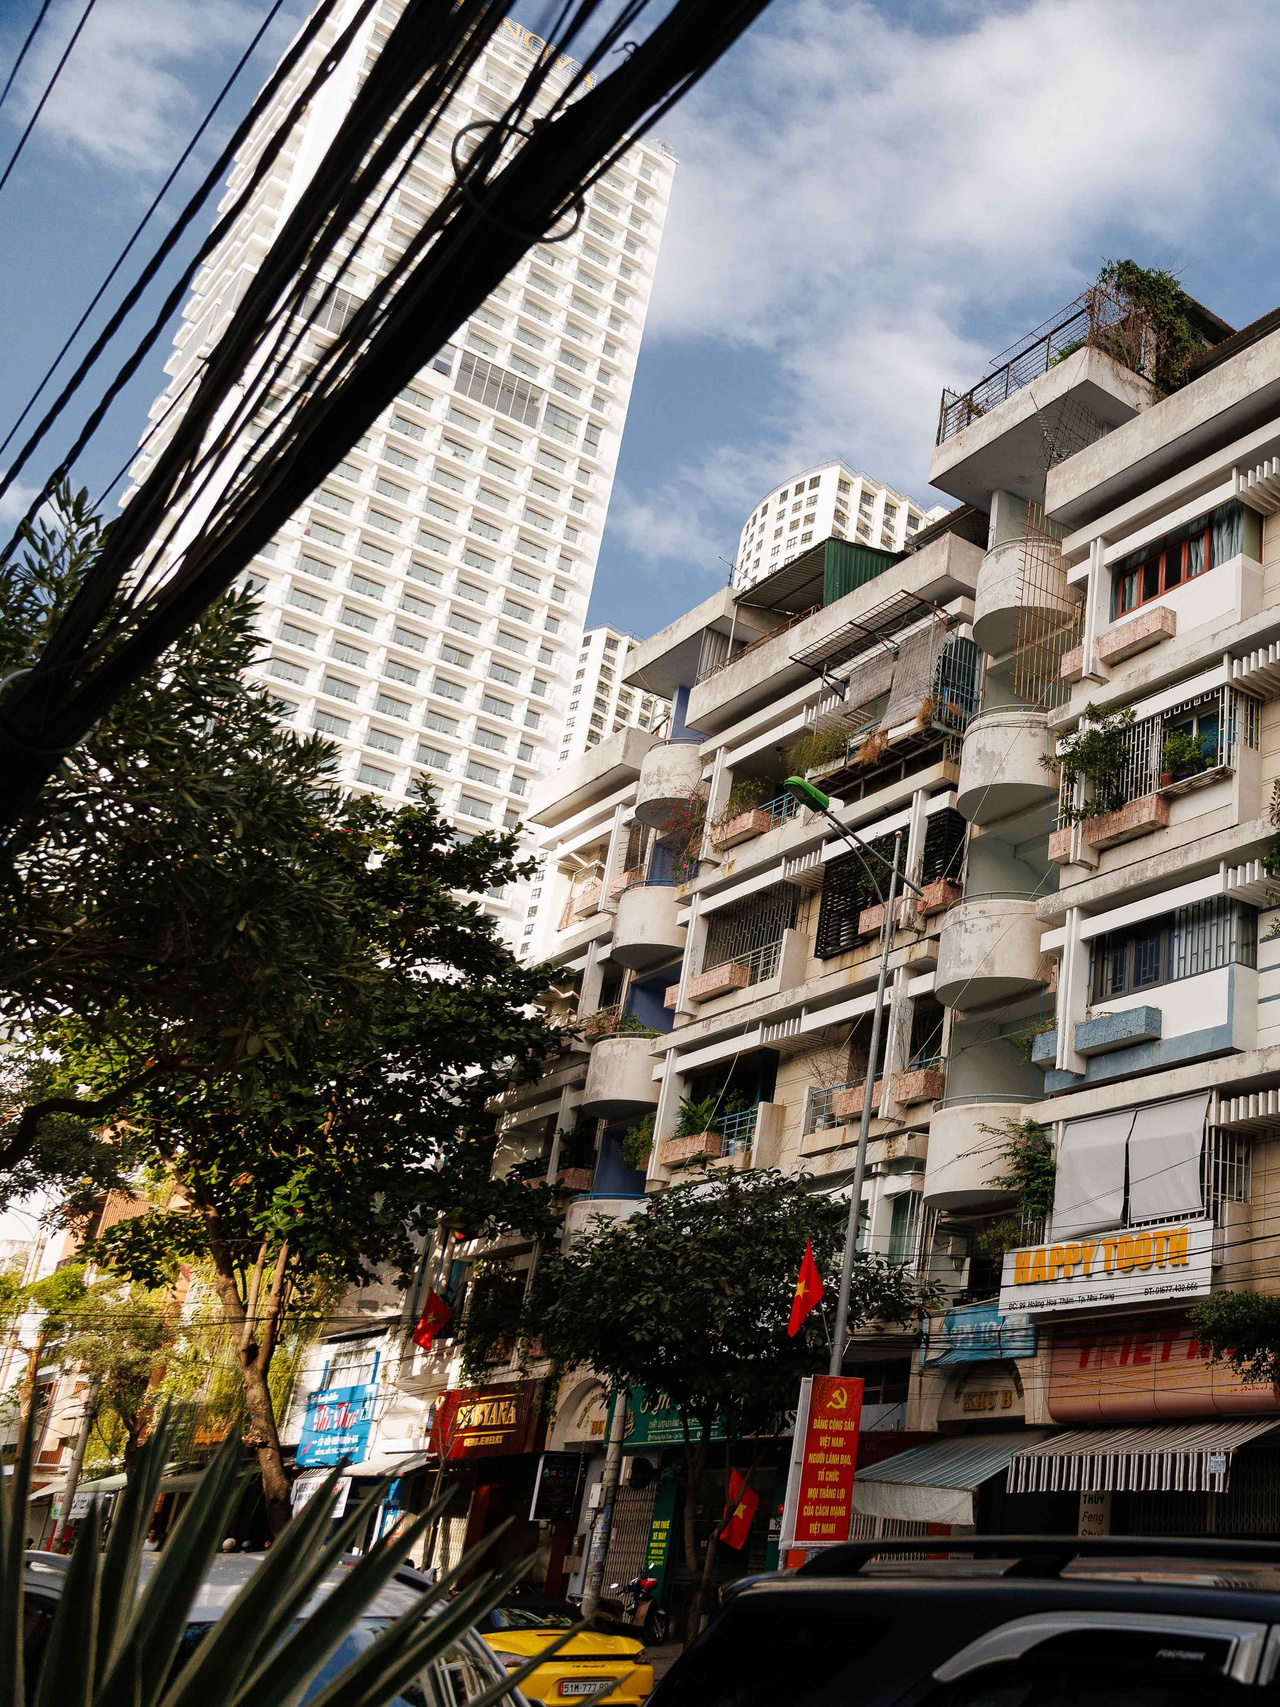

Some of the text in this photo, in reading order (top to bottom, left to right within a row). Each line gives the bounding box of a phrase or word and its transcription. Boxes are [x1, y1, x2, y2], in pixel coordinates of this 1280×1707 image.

[1014, 1227, 1189, 1284] HAPPY TOOTH
[1002, 1390, 1012, 1409] B
[813, 1416, 828, 1429] ĐẢNG
[829, 1418, 843, 1432] CỘNG
[819, 1434, 831, 1449] VIỆT
[815, 1503, 830, 1516] CÁCH
[1082, 1511, 1104, 1525] Feng
[809, 1521, 821, 1536] VIỆT
